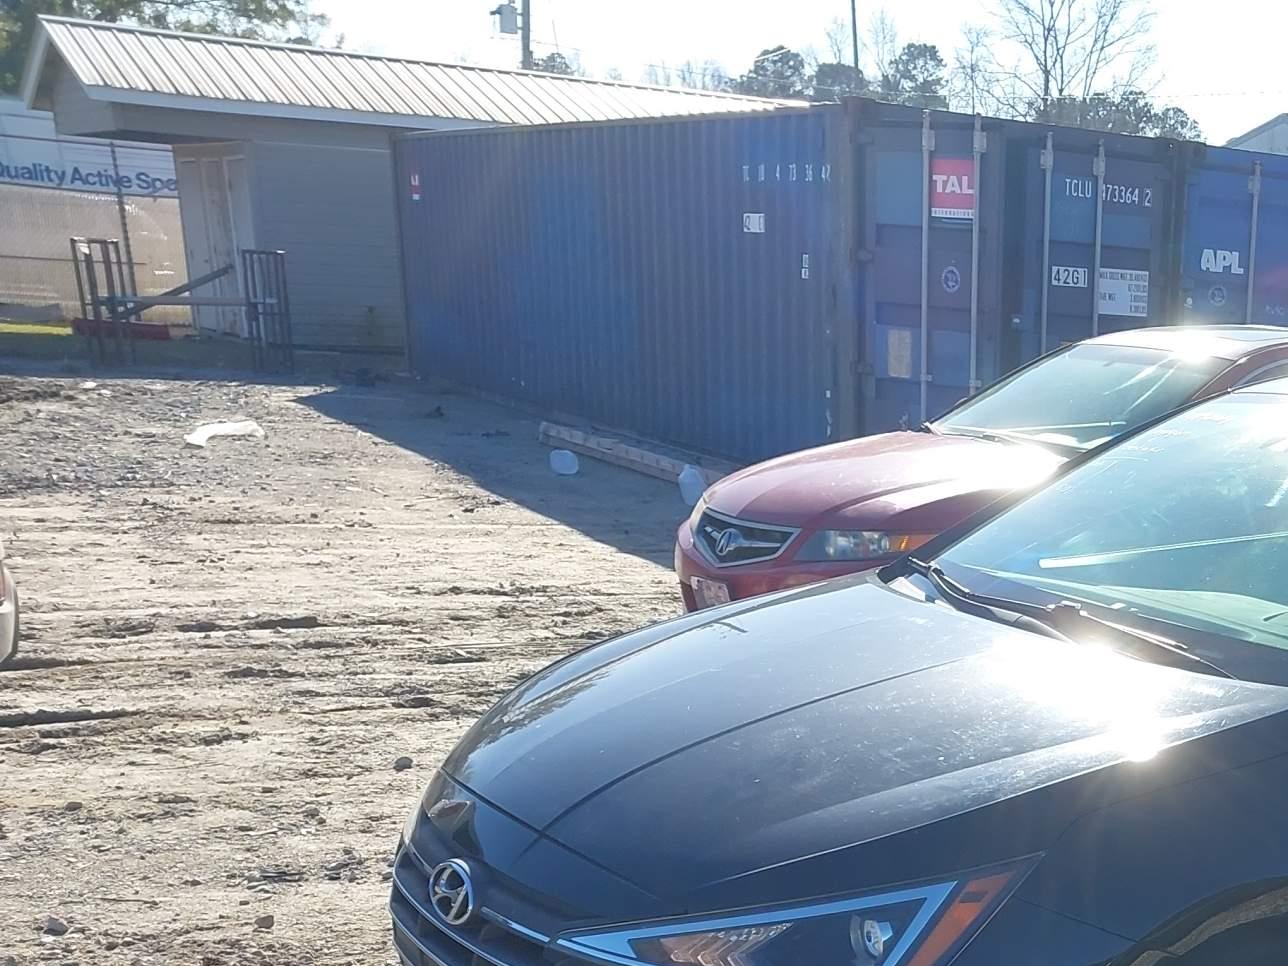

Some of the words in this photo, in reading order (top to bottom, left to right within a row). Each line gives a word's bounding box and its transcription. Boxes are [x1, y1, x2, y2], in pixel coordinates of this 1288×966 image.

[71, 167, 132, 189] Active
[932, 174, 976, 194] TAL
[1065, 178, 1092, 198] TCLU
[1144, 188, 1152, 206] 2
[1200, 248, 1244, 275] APL
